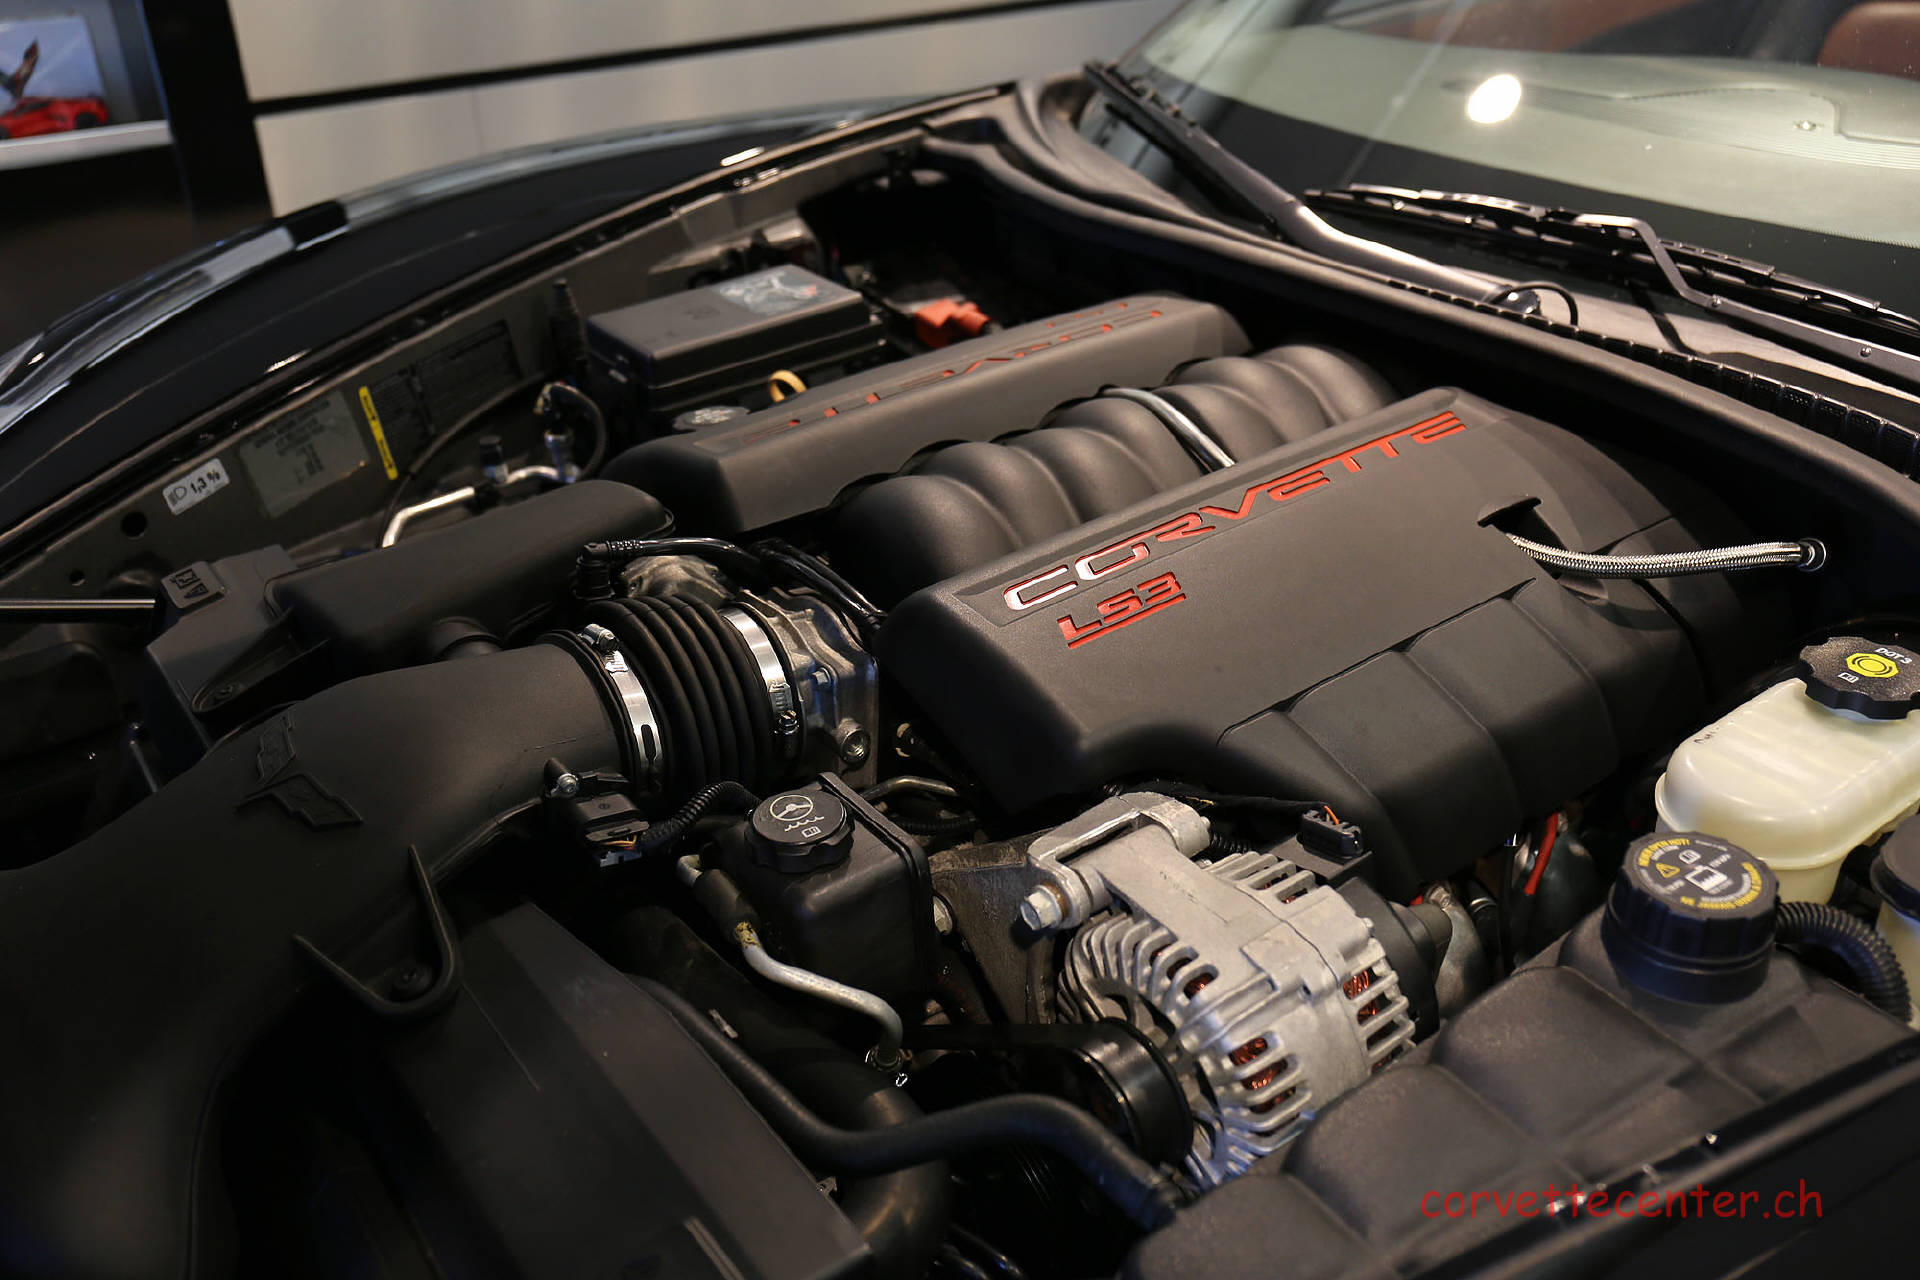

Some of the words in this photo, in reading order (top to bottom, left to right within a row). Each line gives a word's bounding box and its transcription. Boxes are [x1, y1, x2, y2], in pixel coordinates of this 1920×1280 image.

[1003, 411, 1467, 610] CORVETTE
[1057, 571, 1184, 642] LS3
[1875, 648, 1903, 659] DOT
[1900, 656, 1913, 664] 3
